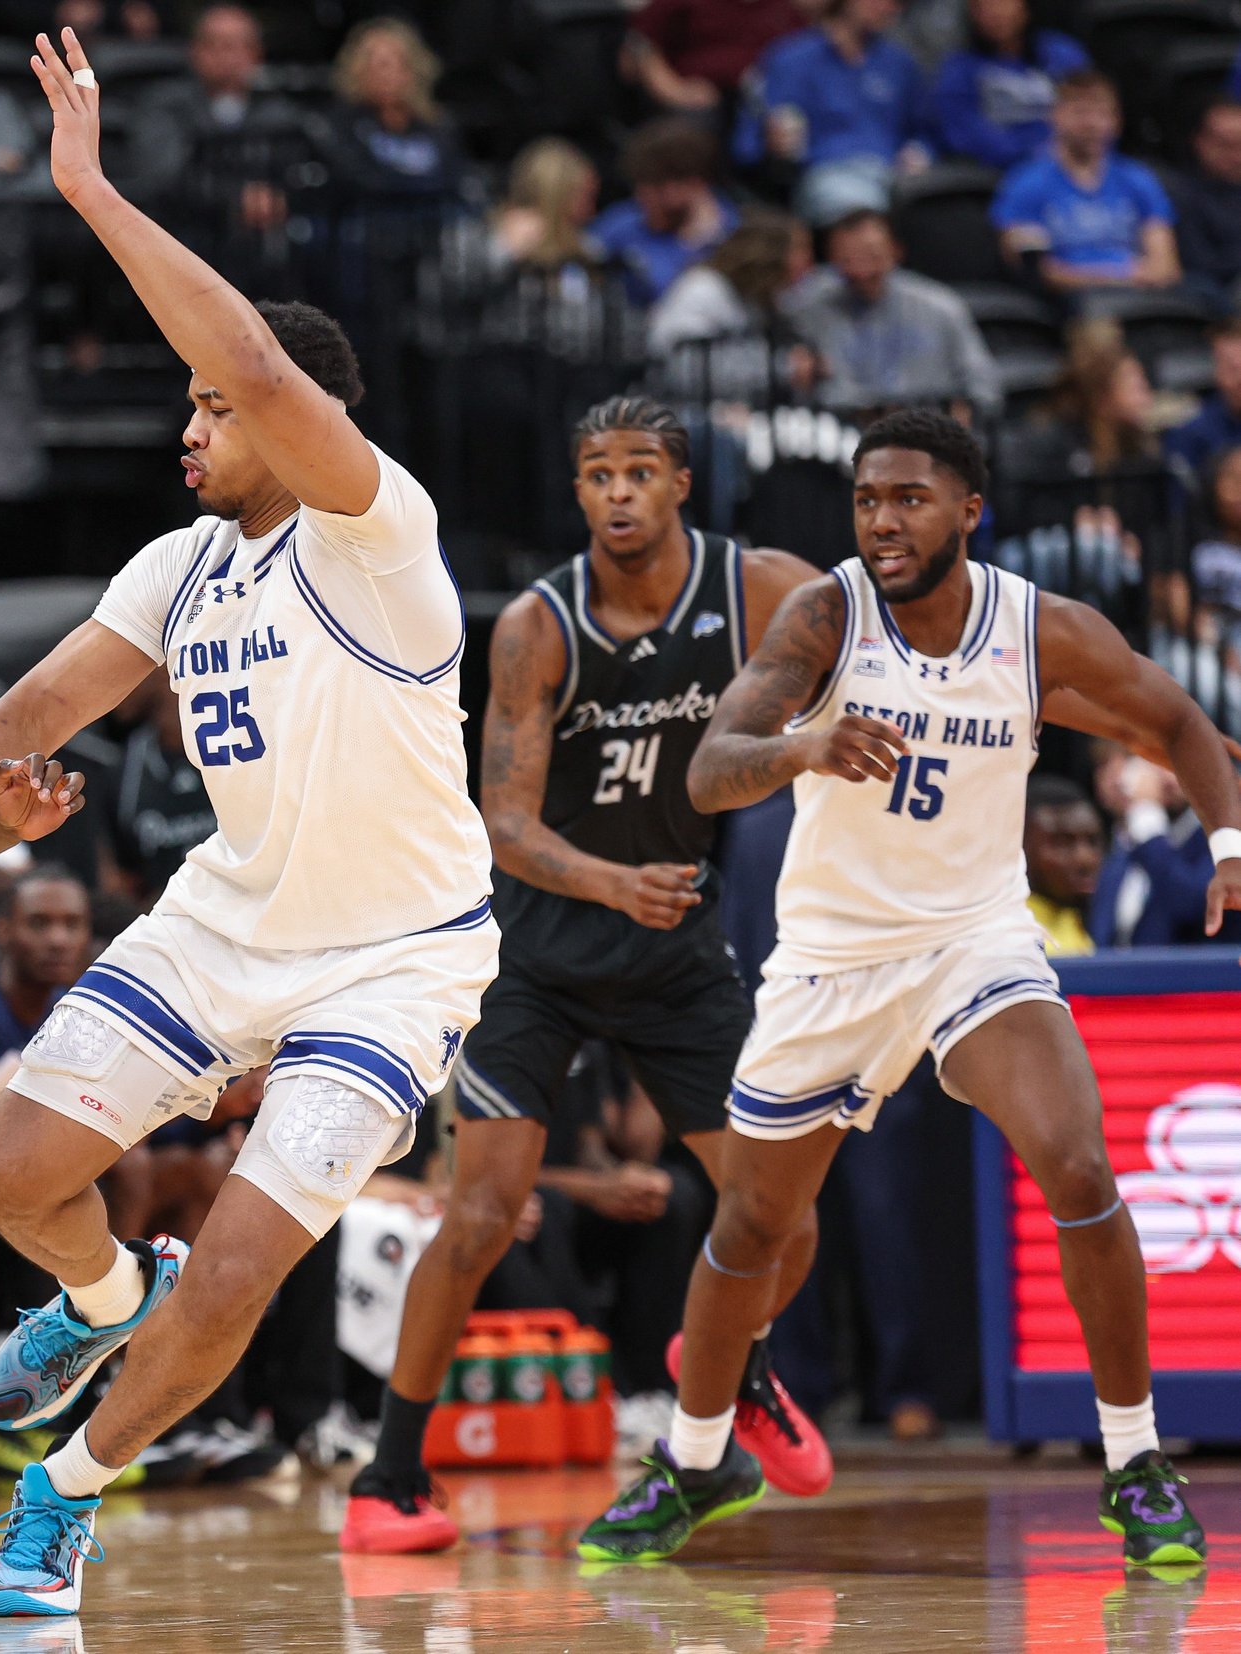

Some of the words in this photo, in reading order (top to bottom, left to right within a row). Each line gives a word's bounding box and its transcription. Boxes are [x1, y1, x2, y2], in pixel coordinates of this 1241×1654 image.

[174, 640, 229, 680] TON
[240, 625, 288, 670] HLL
[191, 686, 266, 766] 25
[942, 716, 1015, 748] HALL
[592, 733, 663, 804] 24
[885, 755, 948, 820] 15
